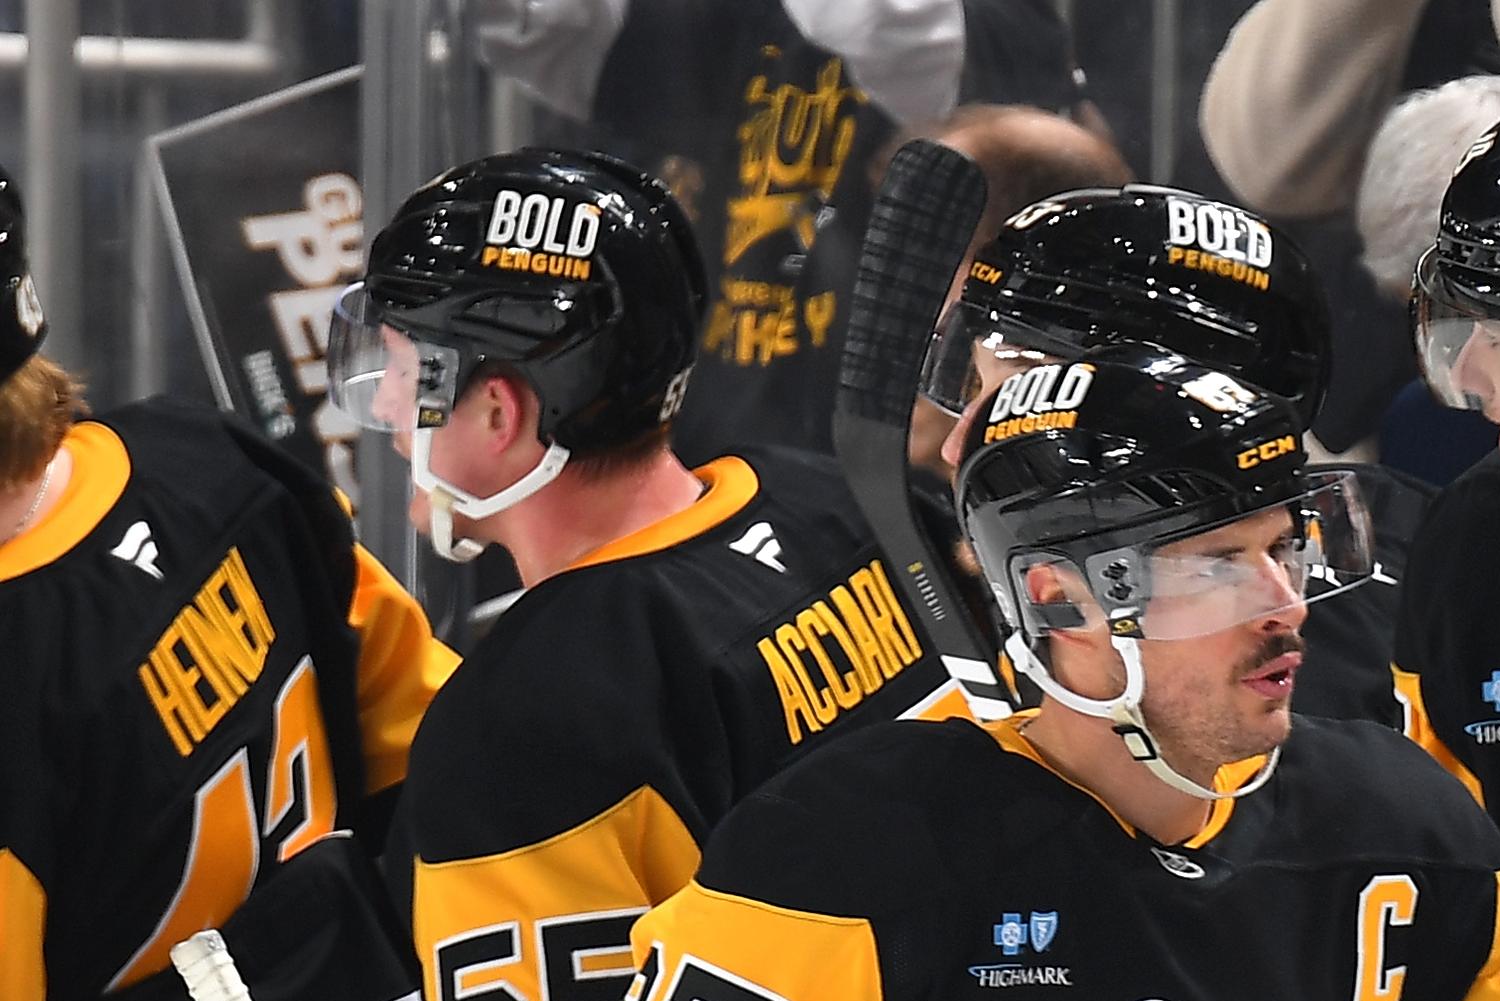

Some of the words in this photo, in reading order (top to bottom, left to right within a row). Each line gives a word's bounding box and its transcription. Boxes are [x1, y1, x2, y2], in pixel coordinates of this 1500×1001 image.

[486, 189, 601, 257] BOLD
[1166, 196, 1272, 268] BOLD
[481, 246, 591, 281] PENGUIN
[1168, 246, 1270, 291] PENGUIN
[989, 363, 1096, 423] BOLD
[984, 411, 1078, 443] PENGUIN
[1237, 435, 1296, 469] CCM
[979, 966, 1073, 988] HIGHMARK
